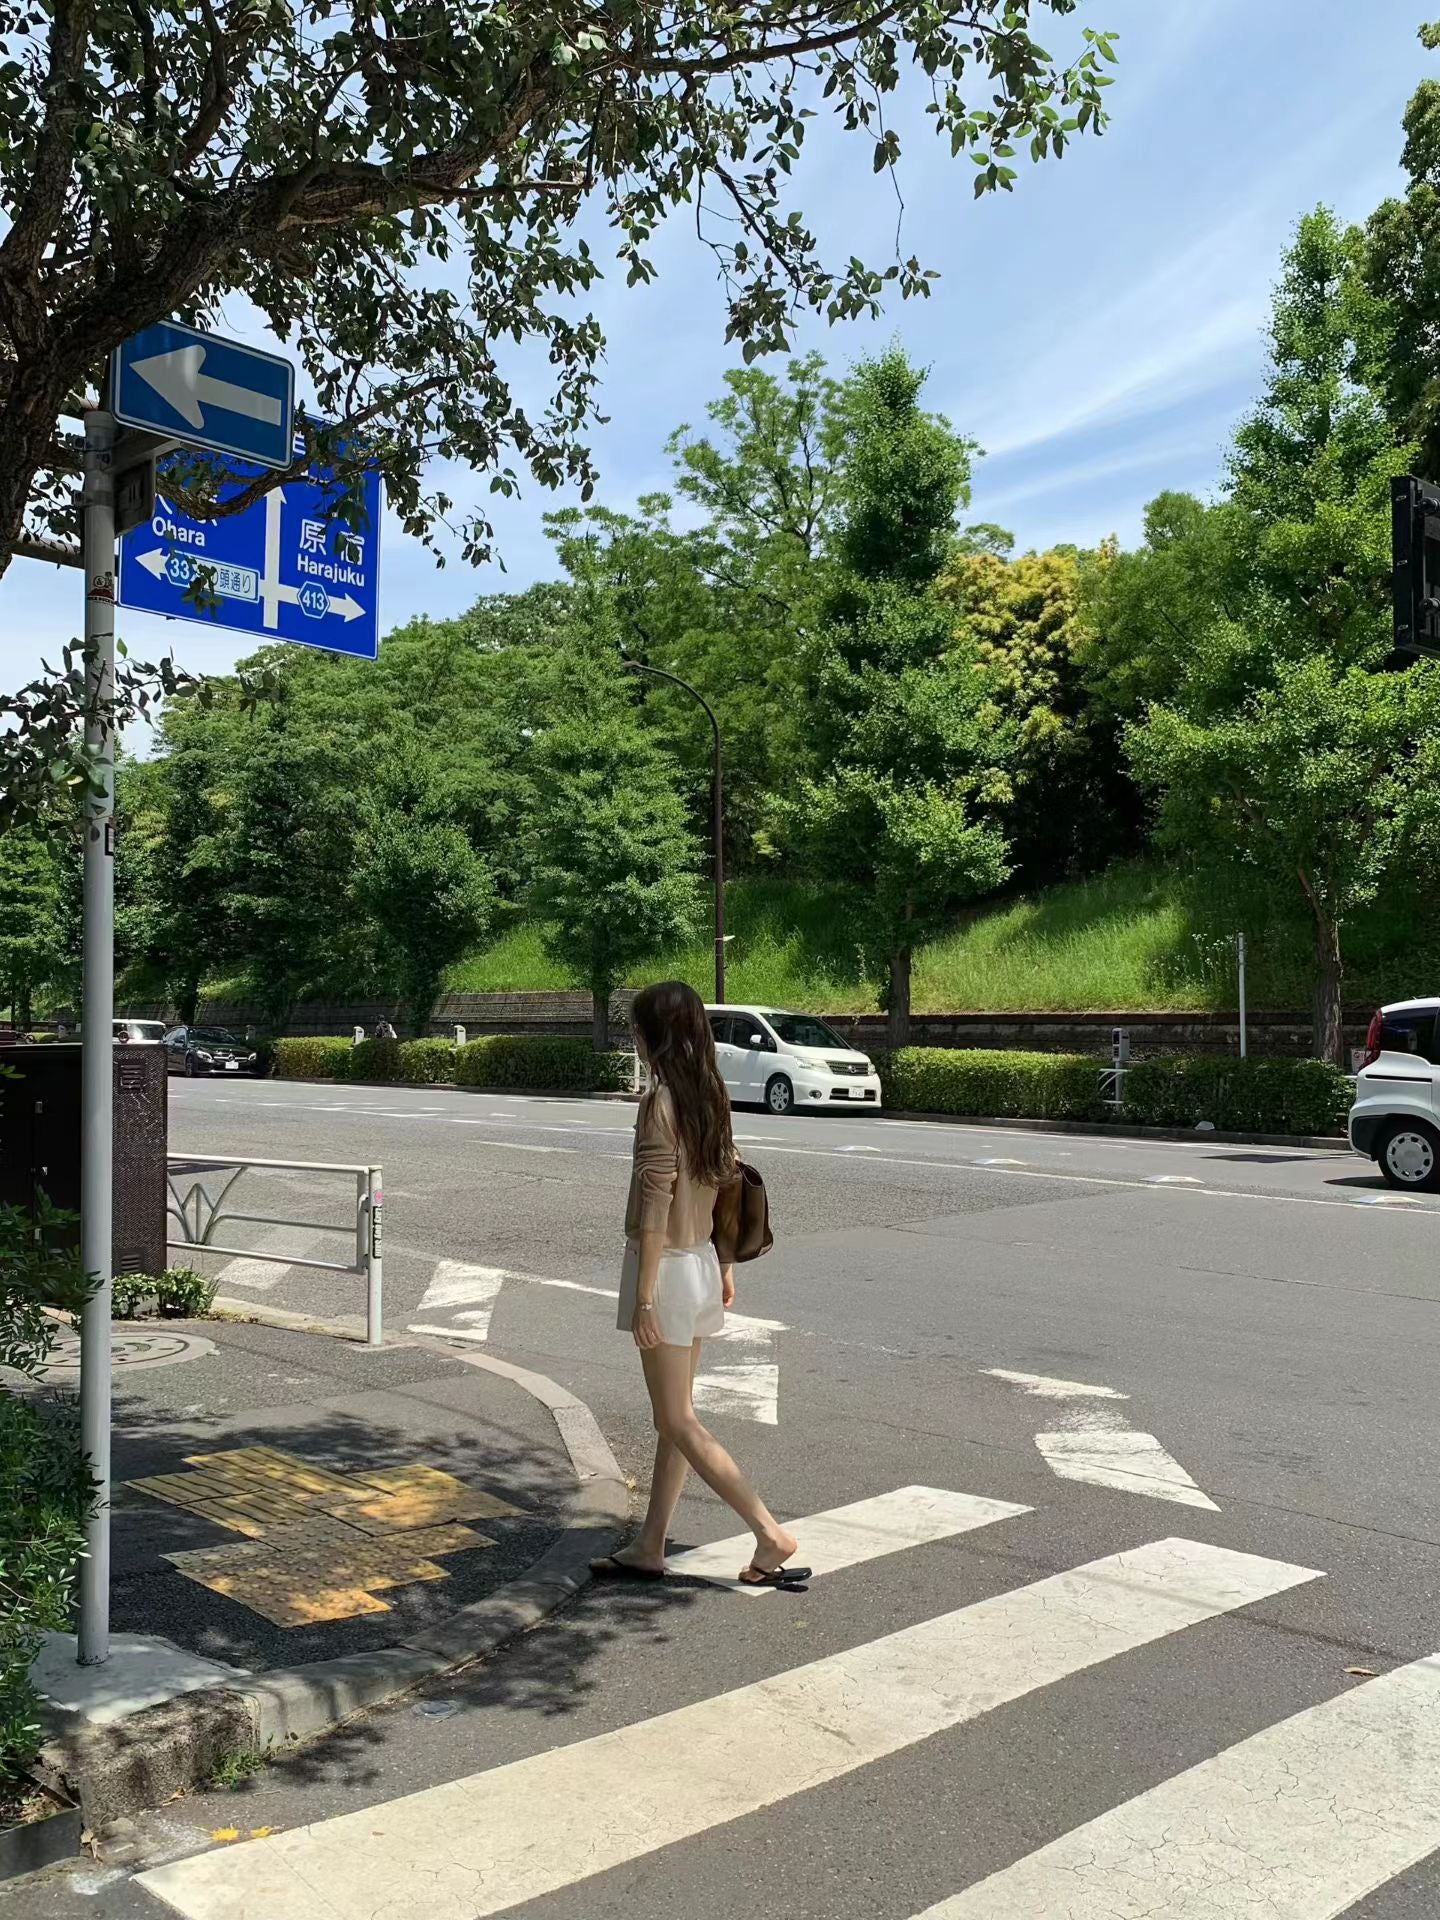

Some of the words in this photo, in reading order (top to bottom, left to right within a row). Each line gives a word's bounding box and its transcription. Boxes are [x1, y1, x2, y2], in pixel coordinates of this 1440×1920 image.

[152, 516, 205, 547] Ohara
[170, 557, 190, 580] 33
[199, 564, 251, 593] の頭通り
[297, 553, 365, 587] Harajuku
[302, 589, 325, 611] 413
